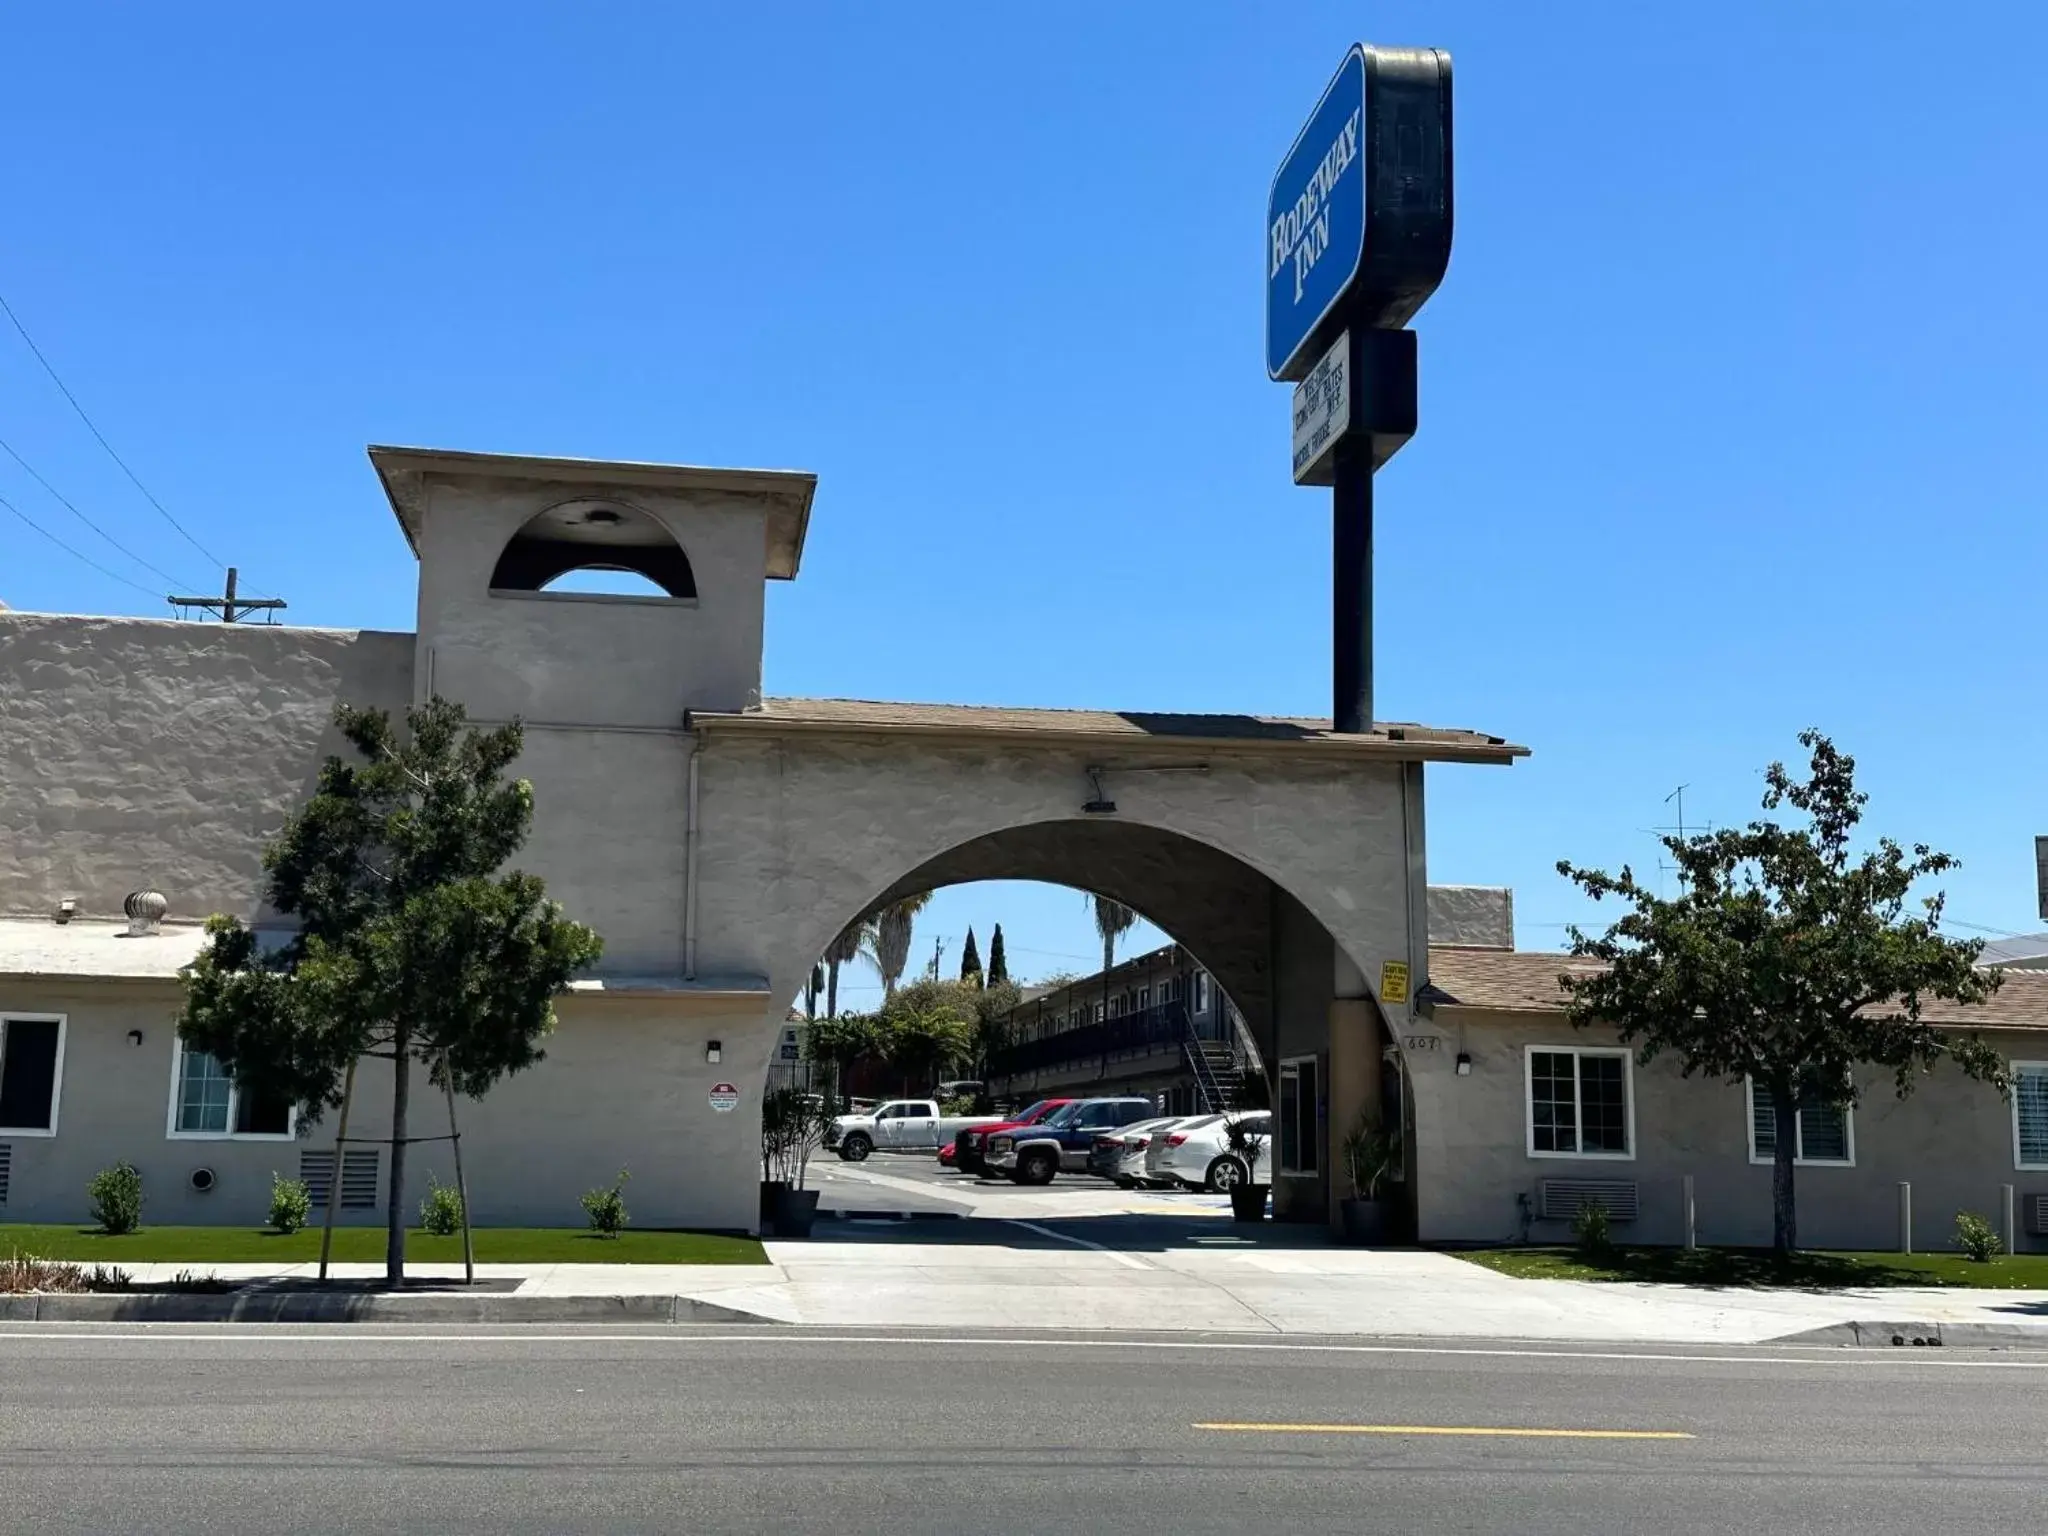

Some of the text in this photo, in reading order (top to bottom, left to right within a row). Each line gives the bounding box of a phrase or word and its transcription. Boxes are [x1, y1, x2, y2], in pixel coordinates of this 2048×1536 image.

[1271, 105, 1361, 281] RODEWAY
[1294, 203, 1331, 306] INN
[1408, 1038, 1437, 1050] 607
